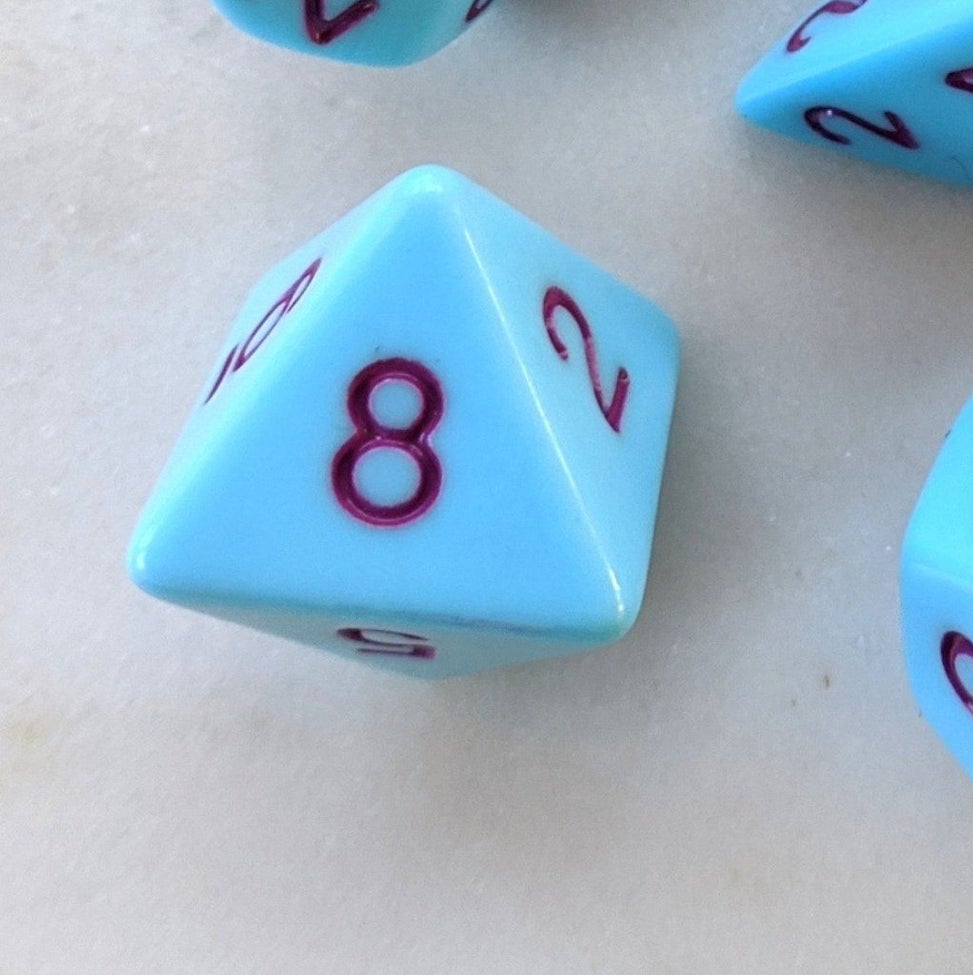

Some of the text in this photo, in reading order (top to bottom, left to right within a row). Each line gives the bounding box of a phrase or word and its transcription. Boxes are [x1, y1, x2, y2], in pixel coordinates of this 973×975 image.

[803, 105, 921, 150] 2
[541, 285, 631, 433] 2
[330, 356, 446, 529] 8
